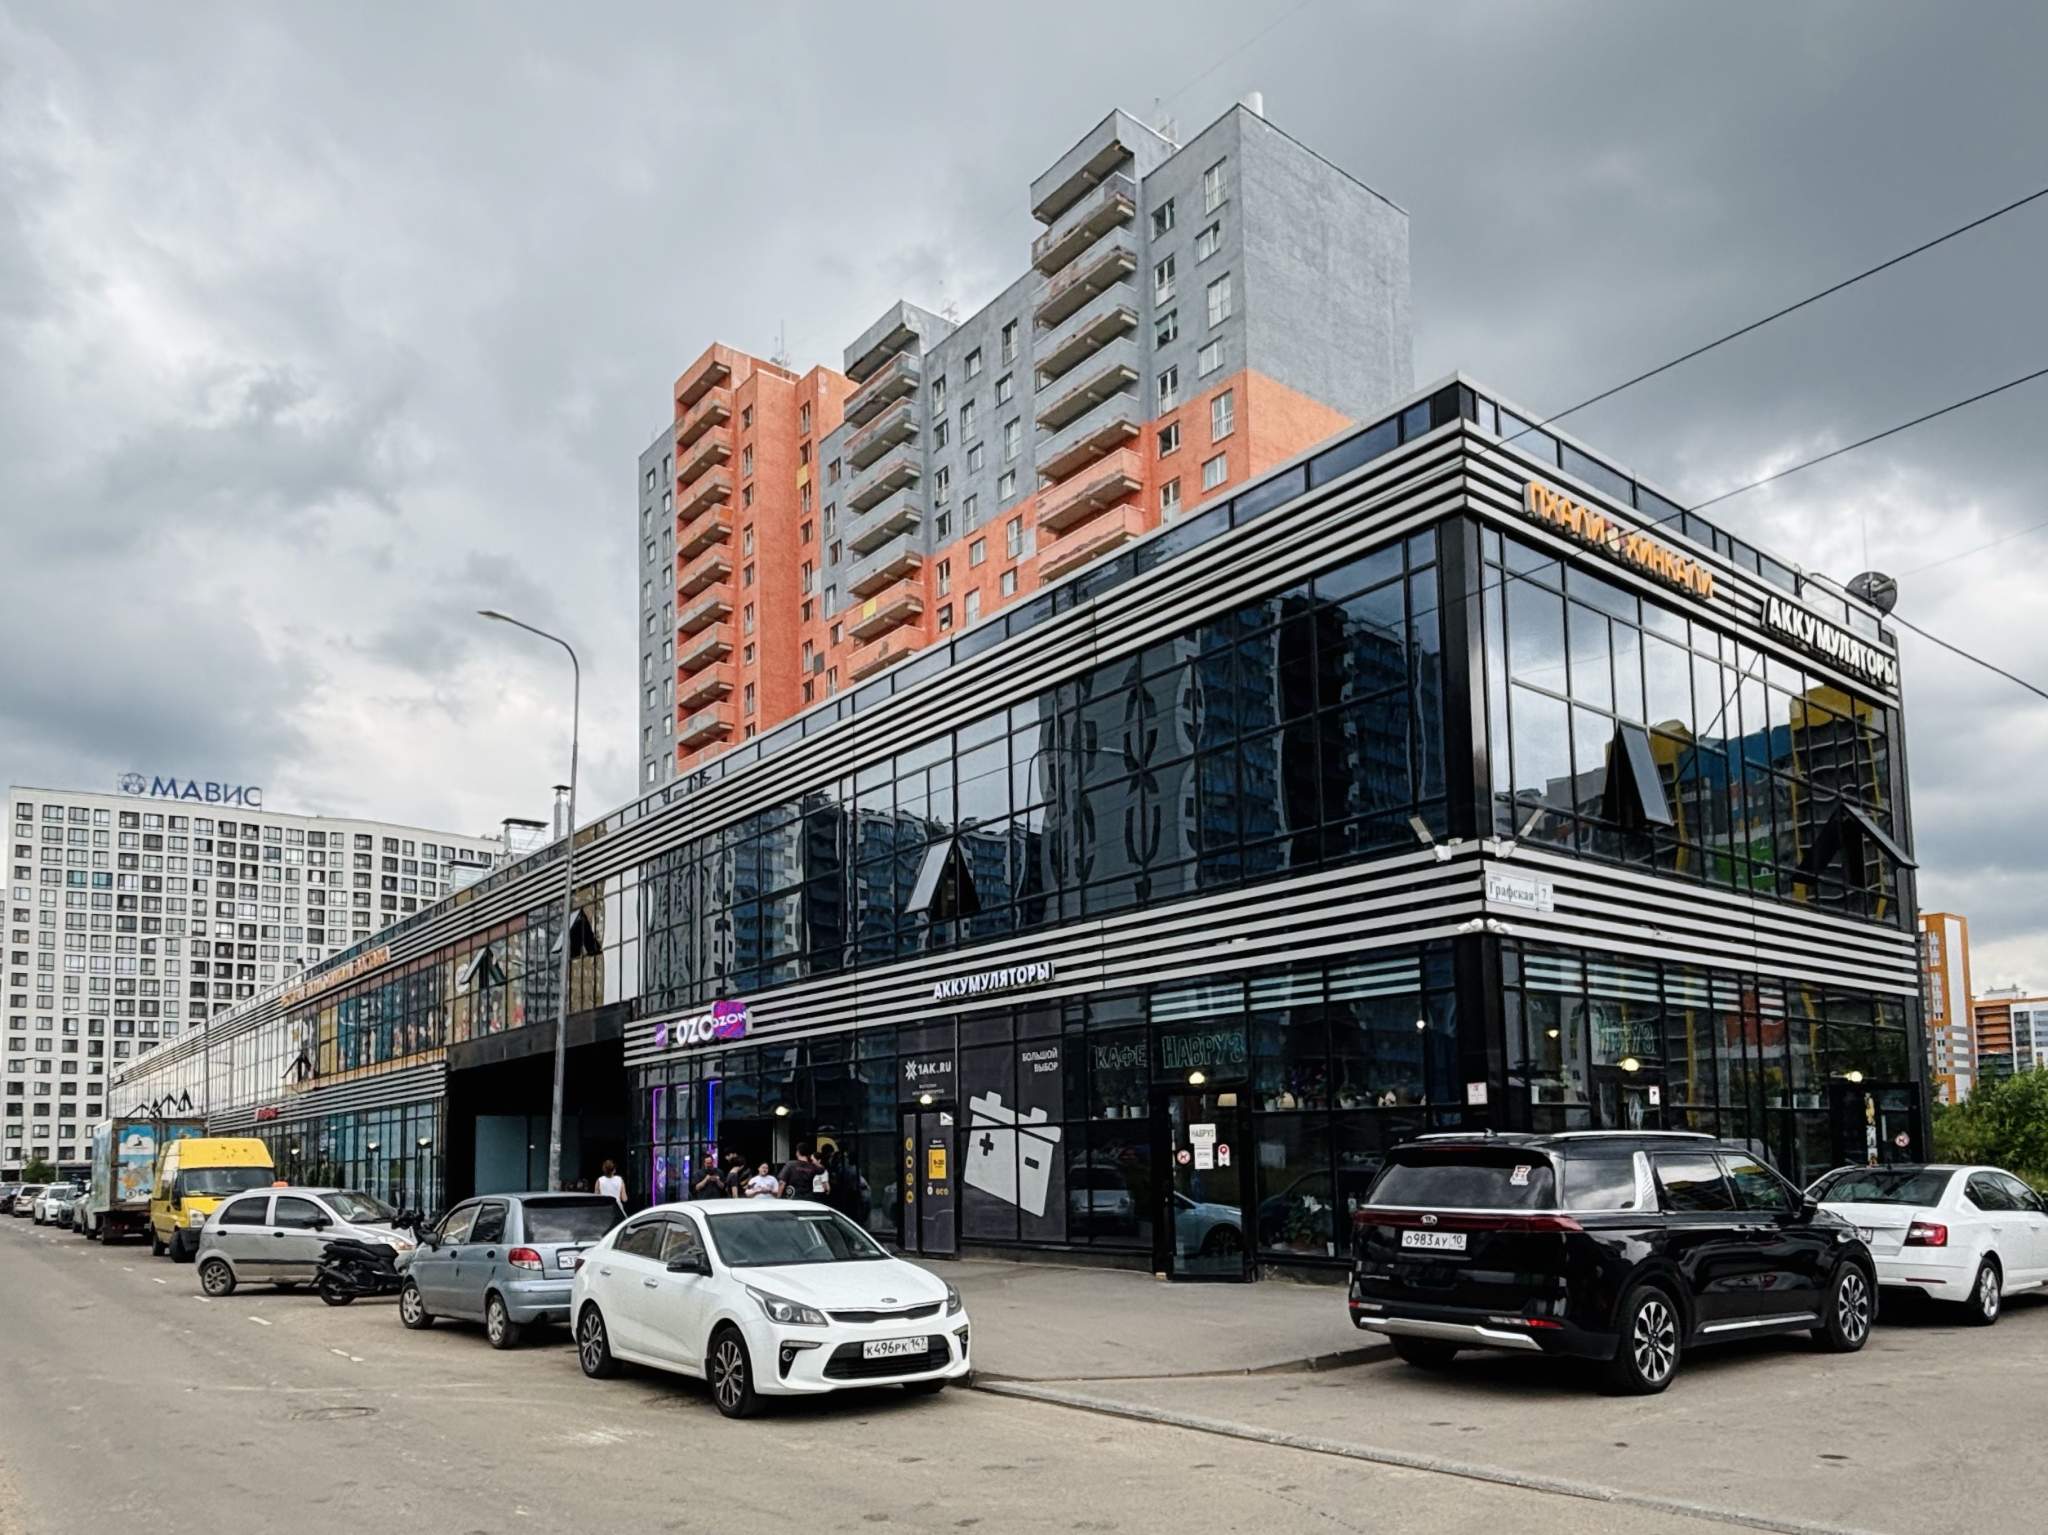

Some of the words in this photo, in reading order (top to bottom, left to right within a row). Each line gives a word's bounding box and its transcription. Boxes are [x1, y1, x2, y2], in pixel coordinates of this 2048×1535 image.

[1526, 480, 1606, 545] ПХАЛИ
[1626, 534, 1714, 598] ХИНКАЛИ
[1768, 596, 1898, 686] АККУМУЛЯТОРЫ
[150, 775, 263, 807] МАВИС
[933, 961, 1051, 999] АККУМУЛЯТОРЫ
[676, 1014, 714, 1046] OZO
[713, 1011, 747, 1028] OZON
[1022, 1047, 1058, 1062] БОЛЬШОЙ
[1095, 1044, 1147, 1070] КАФЕ
[1161, 1032, 1245, 1069] НАВРУЗ
[1034, 1062, 1058, 1073] ВЫБОР
